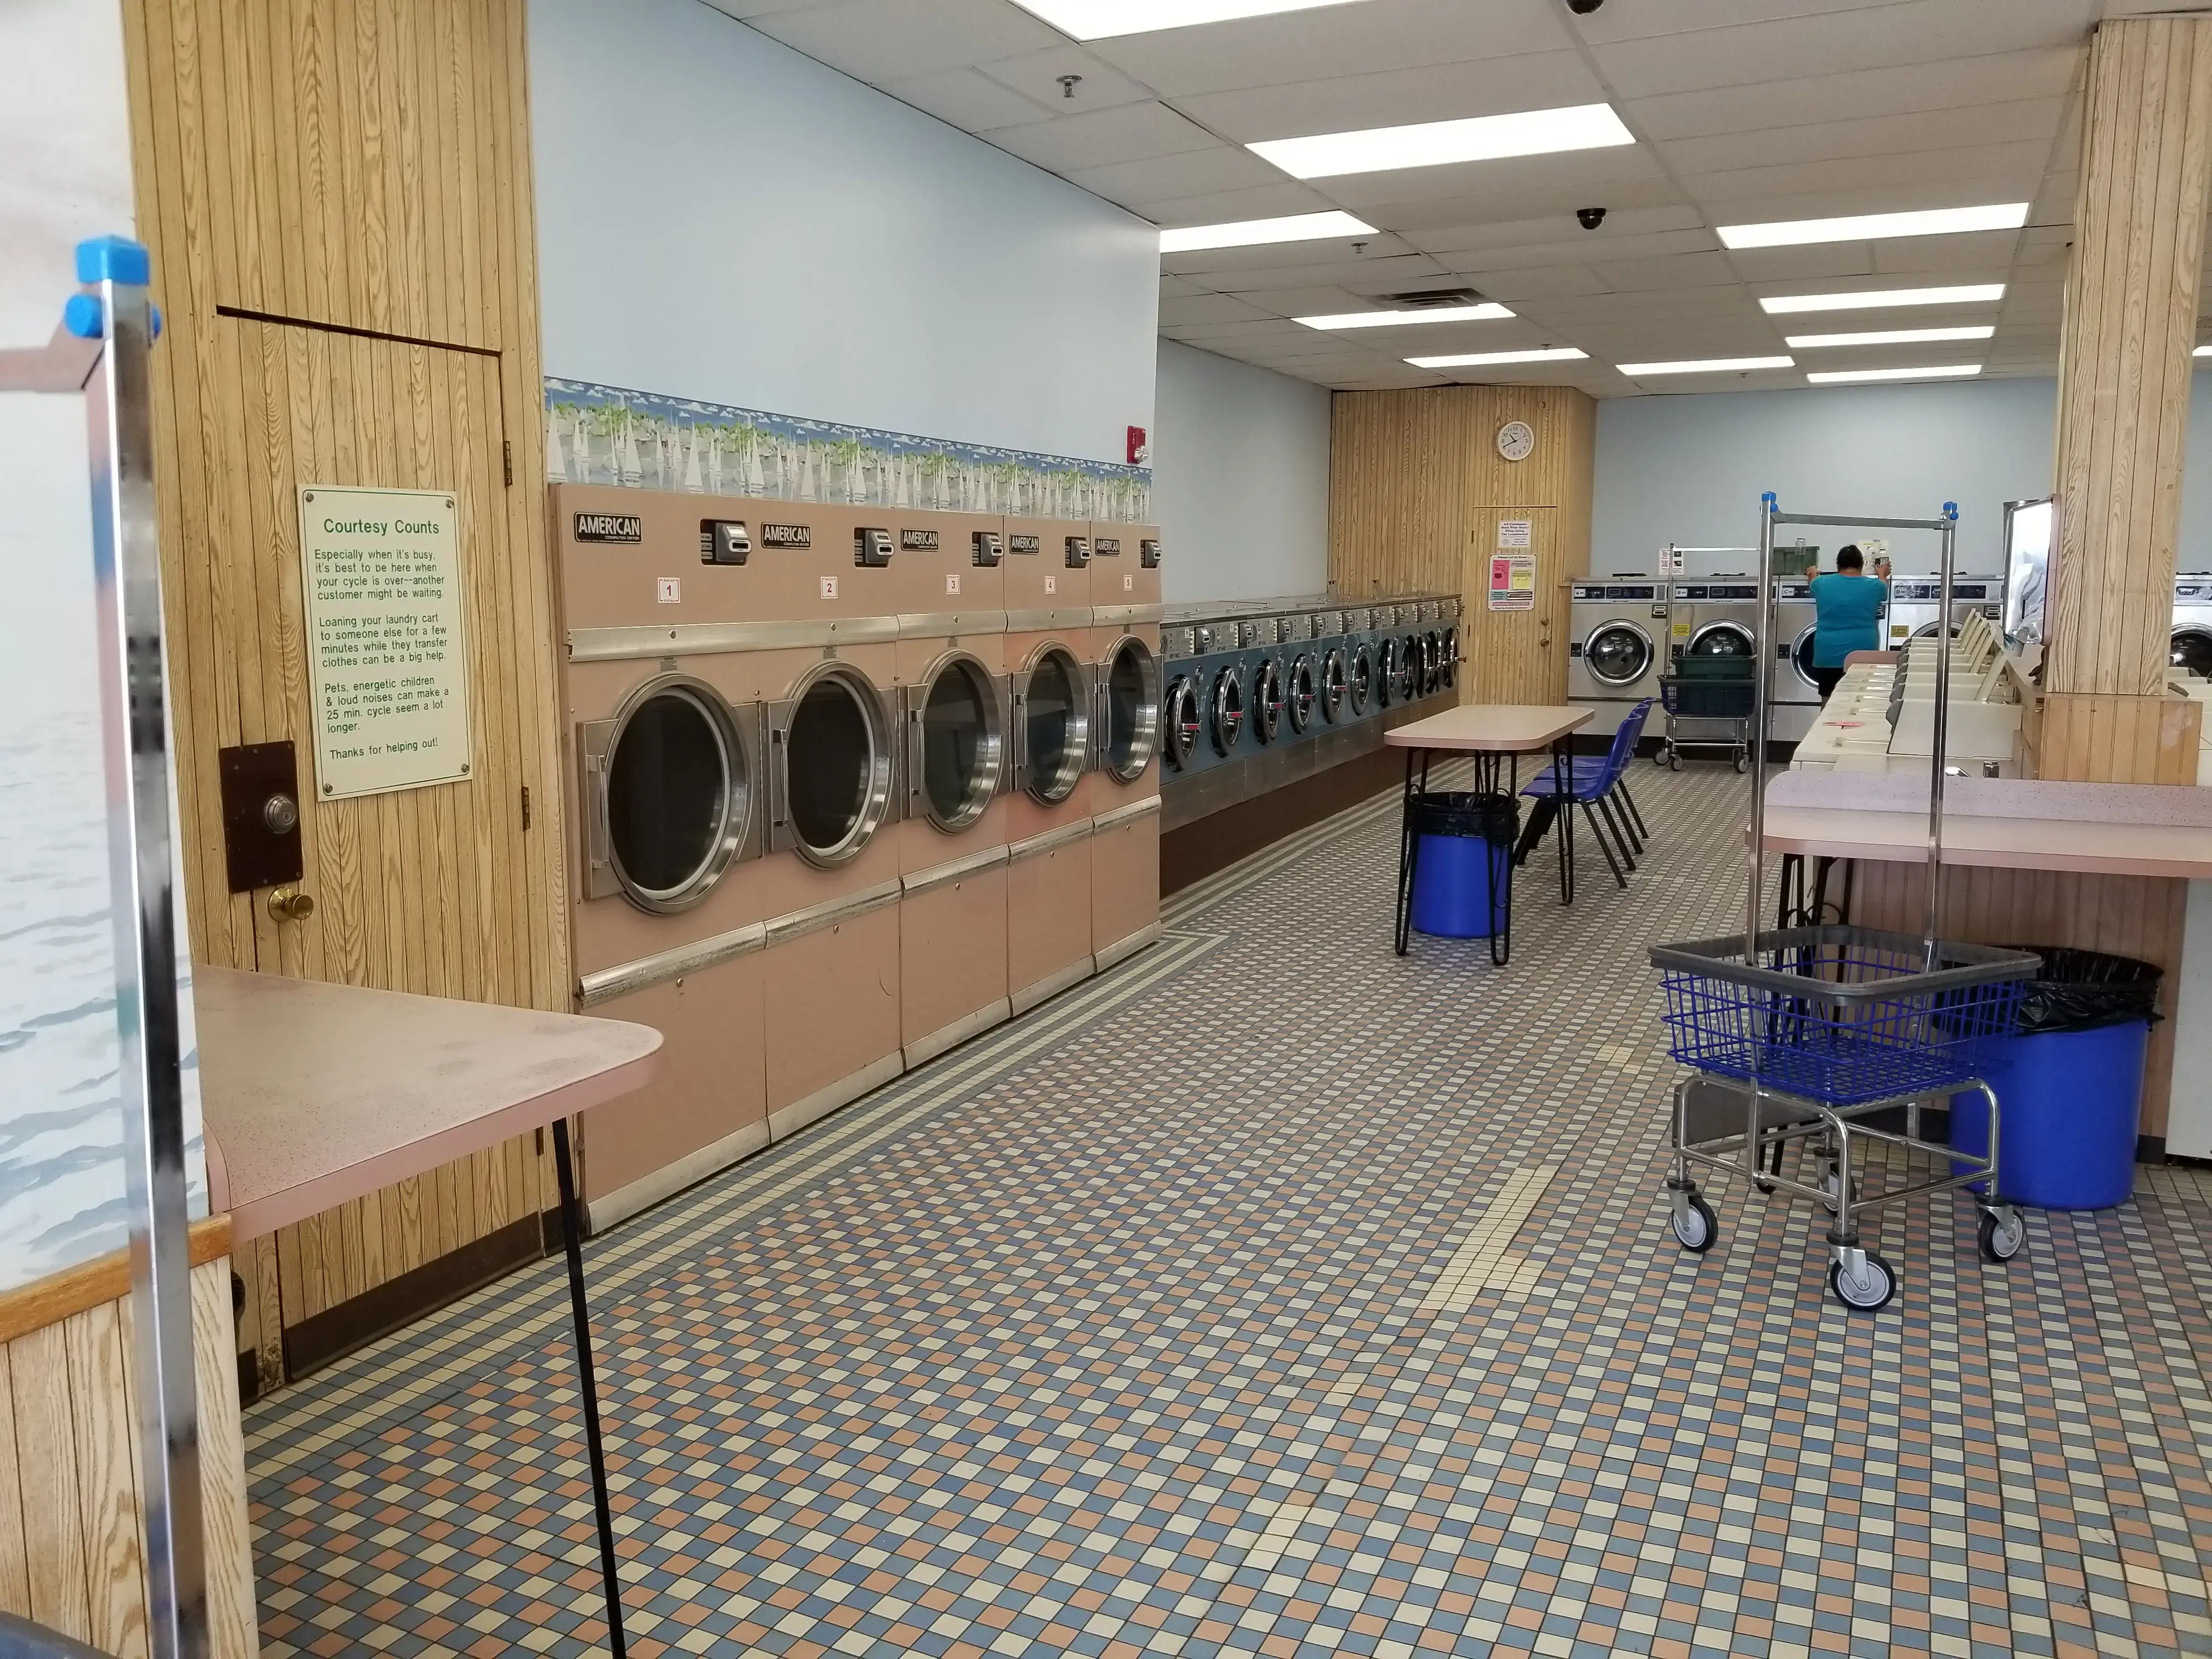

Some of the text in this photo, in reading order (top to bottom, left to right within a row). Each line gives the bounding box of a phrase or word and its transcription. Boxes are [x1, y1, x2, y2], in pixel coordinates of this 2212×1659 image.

[324, 518, 439, 536] Courtesy Counts
[578, 516, 640, 536] AMERICAN
[764, 526, 810, 543] AMERICAN
[903, 531, 938, 546] AMERICAN
[1012, 537, 1039, 549] AMERICAN
[1097, 540, 1119, 551] AMERICAN
[314, 549, 435, 562] Especially when it's busy,
[315, 562, 437, 573] it's best to be here when
[316, 575, 444, 589] your cycle is over--another
[827, 583, 832, 592] 2
[952, 580, 955, 589] 3
[318, 588, 443, 600] customer might be waiting.
[667, 585, 672, 596] 1
[319, 613, 438, 628] Loaning your laundry cart
[320, 631, 330, 640] to
[335, 630, 379, 640] someone
[383, 628, 402, 637] else
[406, 627, 418, 636] for
[431, 625, 446, 635] few
[321, 638, 447, 654] minutes while they transfer
[322, 657, 357, 667] clothes
[383, 654, 394, 663] be
[409, 652, 422, 663] big
[426, 650, 445, 662] help.
[324, 676, 434, 693] Pets, energetic children
[326, 697, 332, 707] &
[337, 695, 358, 706] loud
[363, 693, 392, 703] noises
[417, 688, 439, 698] make
[326, 709, 338, 720] 25
[343, 708, 362, 718] min.
[367, 705, 391, 718] cycle
[396, 704, 419, 713] seem
[432, 699, 443, 709] lot
[328, 723, 360, 733] longer.
[329, 737, 438, 759] Thanks for helping out!
